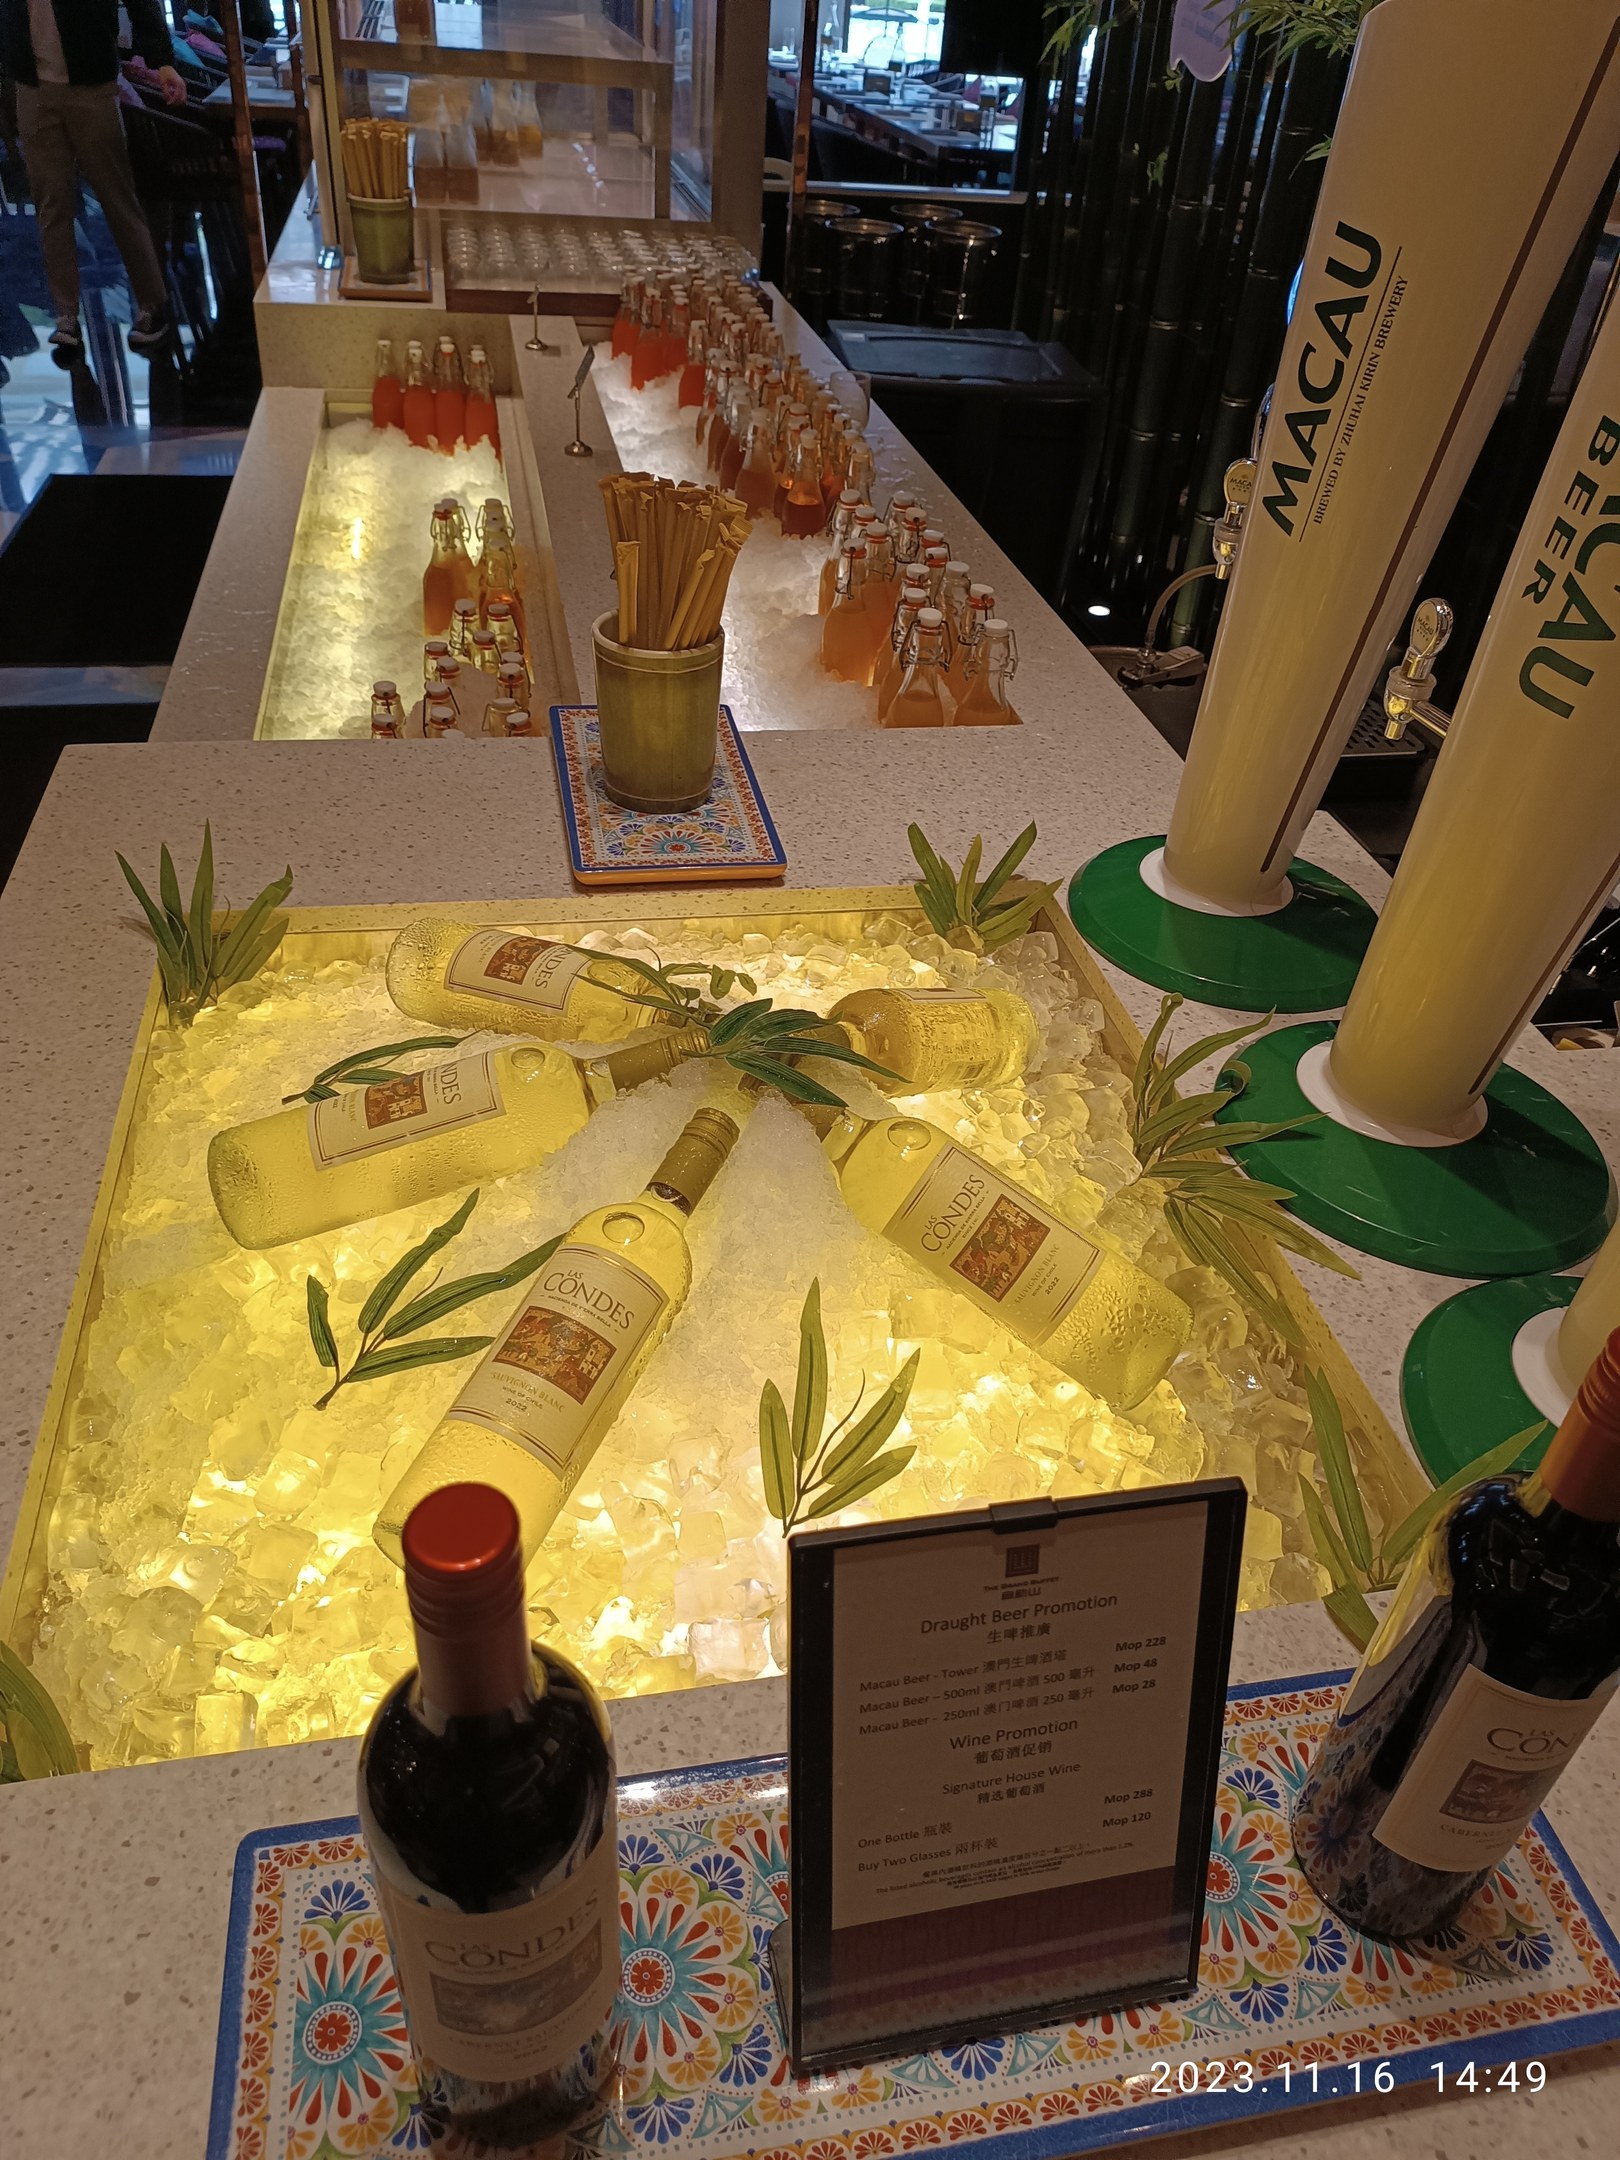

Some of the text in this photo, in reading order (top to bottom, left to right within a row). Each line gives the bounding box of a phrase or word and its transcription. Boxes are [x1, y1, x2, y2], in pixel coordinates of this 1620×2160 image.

[1262, 220, 1382, 537] MACAU
[1313, 275, 1409, 524] BREWED BY ZHUHAI KIRIN BREWERY
[1229, 477, 1252, 487] MACA
[1521, 415, 1620, 605] BEER
[1519, 495, 1620, 720] CAU
[440, 1062, 462, 1105] NDES
[921, 1174, 985, 1252] CONDES
[925, 1215, 938, 1231] LAS
[566, 1269, 584, 1280] LAS
[543, 1272, 635, 1330] CONDES
[920, 1595, 1118, 1634] Draught Beer Promotion
[859, 1679, 900, 1692] Macau
[903, 1673, 931, 1685] Beer
[941, 1666, 979, 1679] Tower
[1115, 1641, 1142, 1653] Mop
[1145, 1636, 1167, 1648] 228
[859, 1701, 900, 1714] Macau
[903, 1695, 930, 1707] Beer
[943, 1685, 980, 1700] 500ml
[1043, 1672, 1065, 1684] 500
[1113, 1662, 1141, 1674] Mop
[1143, 1658, 1158, 1669] 48
[859, 1722, 899, 1735] Macau
[902, 1716, 929, 1728] Beer
[943, 1706, 980, 1722] 250ml
[1043, 1693, 1064, 1706] 250
[1112, 1683, 1139, 1695] Mop
[1141, 1679, 1156, 1690] 28
[950, 1719, 1078, 1750] Wine Promotion
[1486, 1727, 1578, 1754] CON
[942, 1763, 1081, 1795] Signature House Wine
[1104, 1788, 1153, 1806] Mop 288
[858, 1836, 882, 1848] One
[885, 1830, 920, 1844] Bottle
[1102, 1811, 1151, 1829] Mop 120
[858, 1860, 880, 1873] Buy
[882, 1856, 907, 1868] Two
[909, 1848, 952, 1863] Glasses
